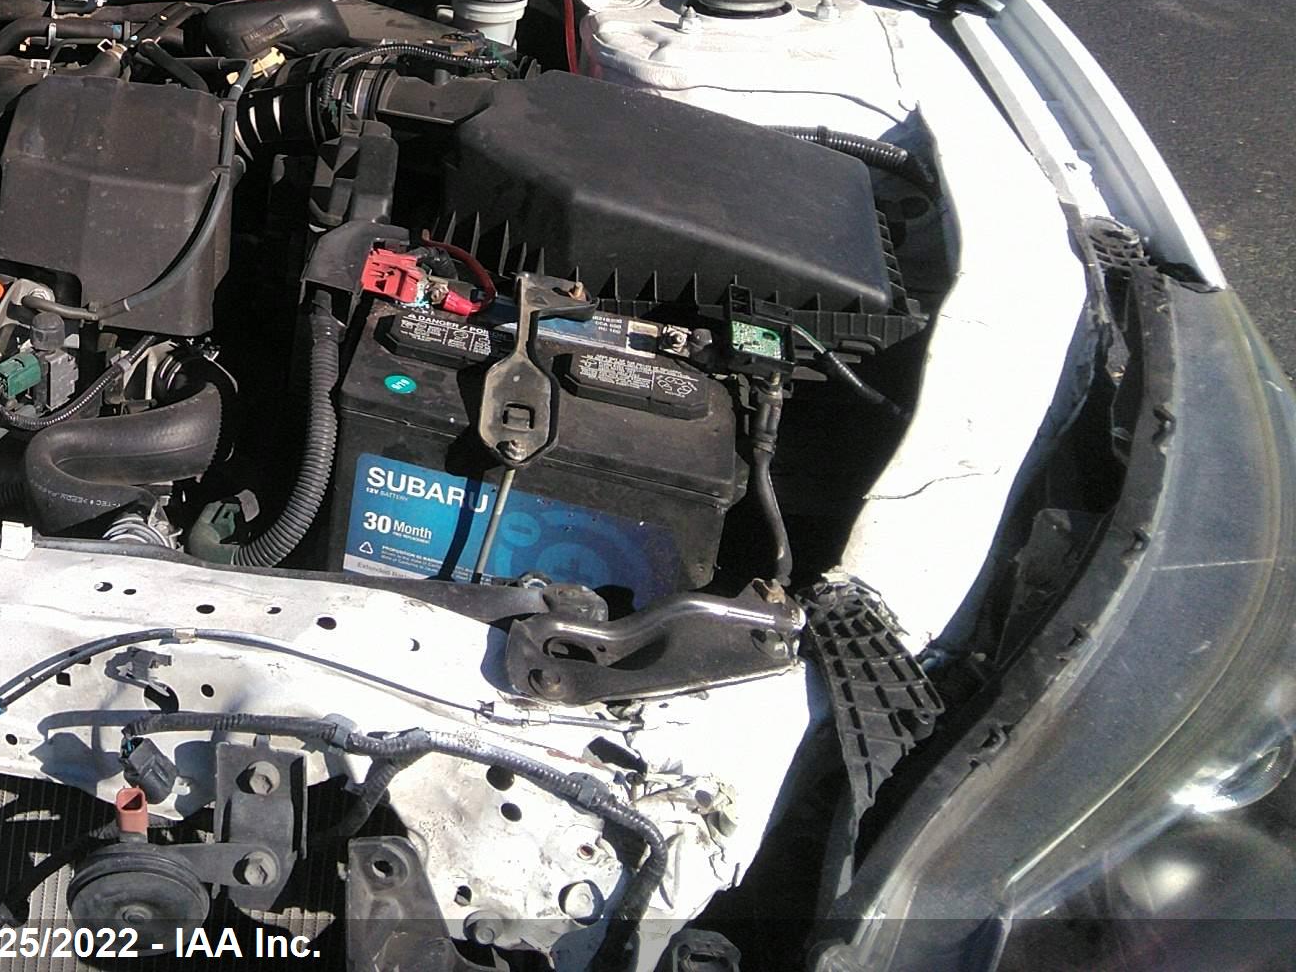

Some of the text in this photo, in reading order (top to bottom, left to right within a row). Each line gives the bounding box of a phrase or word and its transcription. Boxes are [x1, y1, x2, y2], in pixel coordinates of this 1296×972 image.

[418, 315, 459, 328] DANGER
[366, 466, 489, 513] SUBARU
[366, 486, 379, 495] 12V
[363, 511, 433, 540] 30 Month
